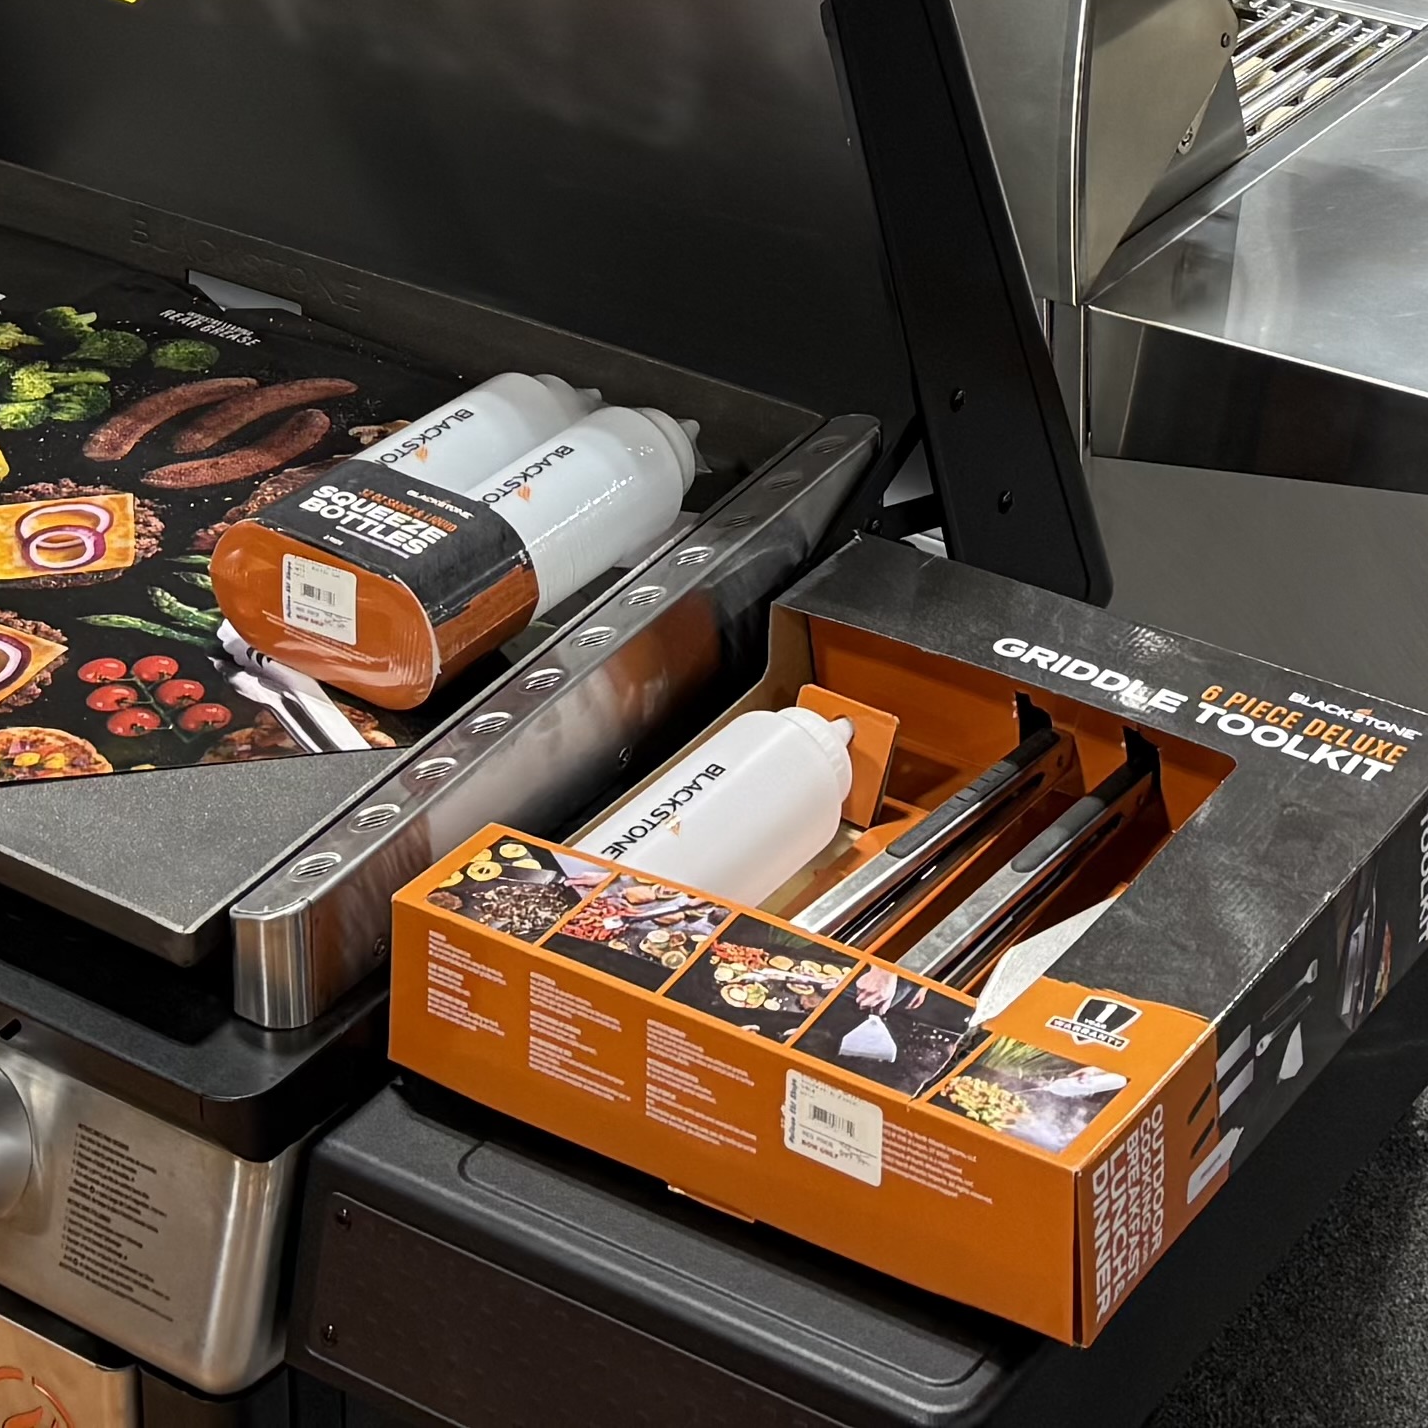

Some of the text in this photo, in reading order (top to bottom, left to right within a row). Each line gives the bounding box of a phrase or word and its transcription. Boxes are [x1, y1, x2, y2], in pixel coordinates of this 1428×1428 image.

[199, 322, 262, 347] GREASE
[381, 408, 475, 466] BLACKSTO
[406, 489, 474, 519] BLACKSTONE
[482, 444, 575, 504] BLACKSTO
[299, 497, 428, 555] BOTTLES
[313, 485, 448, 544] SQUEEZE
[992, 637, 1394, 783] GRIDDLE TOOLKIT
[1200, 685, 1408, 765] 6 PIECE DELUXE
[1288, 691, 1422, 742] BLACKSTONE
[601, 763, 726, 860] BLACKSTONE
[1052, 1019, 1124, 1048] WARRANTY
[1096, 1004, 1118, 1024] 1
[1126, 1128, 1141, 1282] BREAKFAST
[1140, 1117, 1152, 1233] COOKING
[1151, 1103, 1165, 1256] OUTDOOR
[1092, 1160, 1111, 1324] DINNER
[1110, 1143, 1127, 1303] LUNCH &
